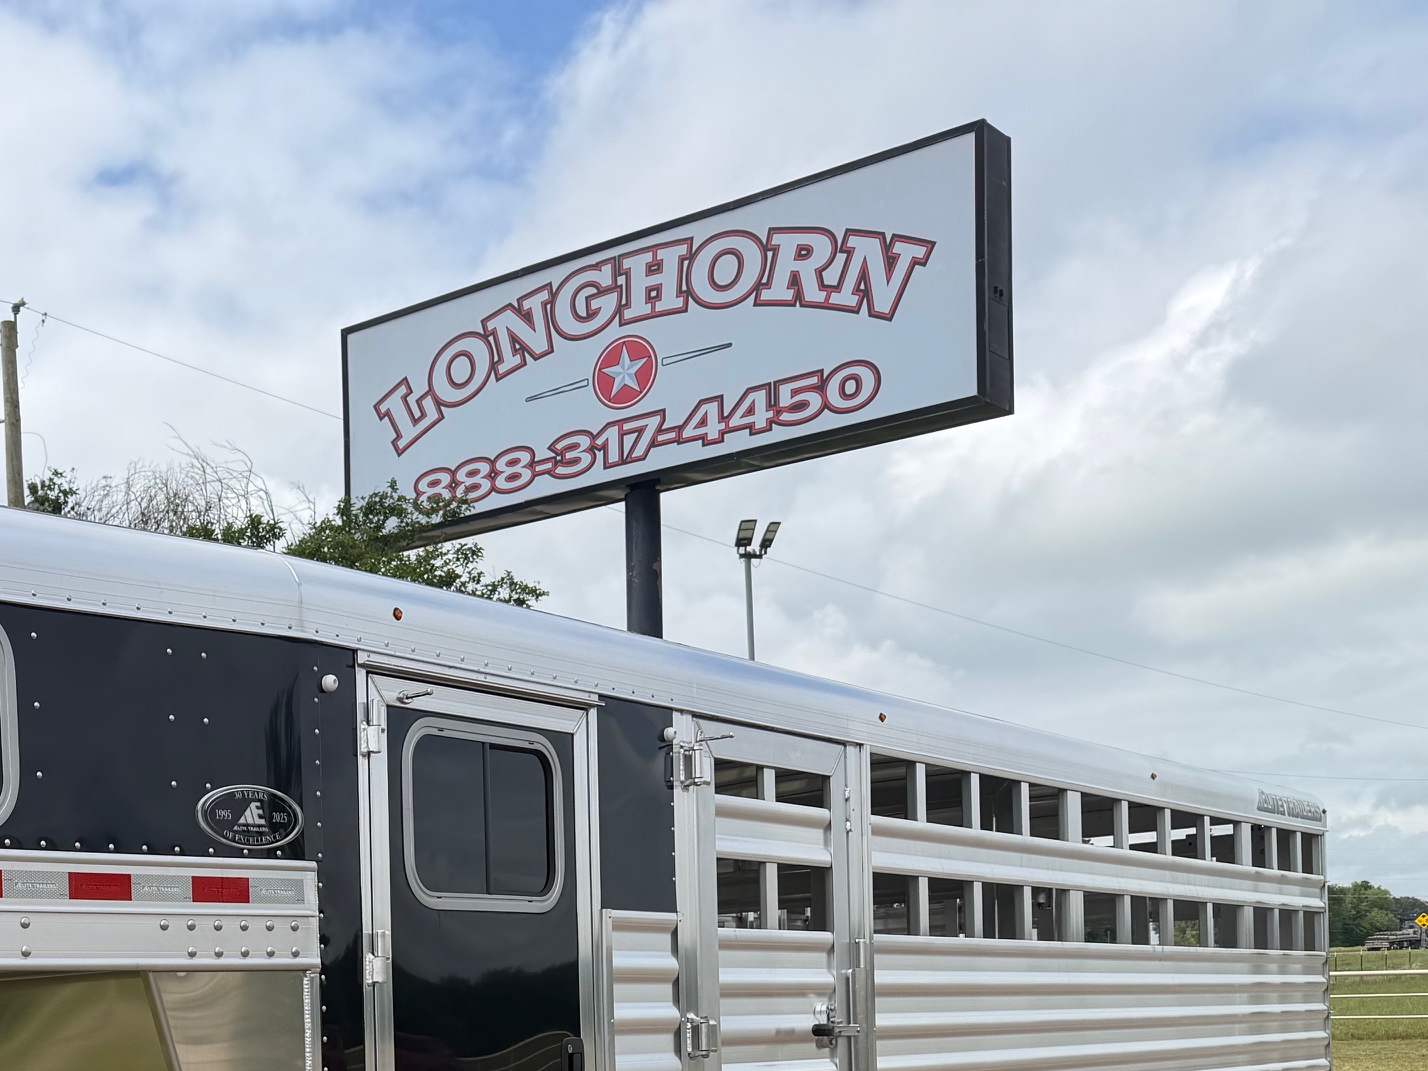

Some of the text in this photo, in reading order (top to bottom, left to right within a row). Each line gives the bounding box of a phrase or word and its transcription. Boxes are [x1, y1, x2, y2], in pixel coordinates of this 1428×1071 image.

[373, 226, 937, 457] LONGHORN
[413, 359, 881, 511] 888-317-4450
[234, 790, 268, 801] 30 YEARS
[215, 809, 232, 820] 1995
[272, 812, 288, 823] 2025
[223, 829, 281, 845] OF EXCELLENCE
